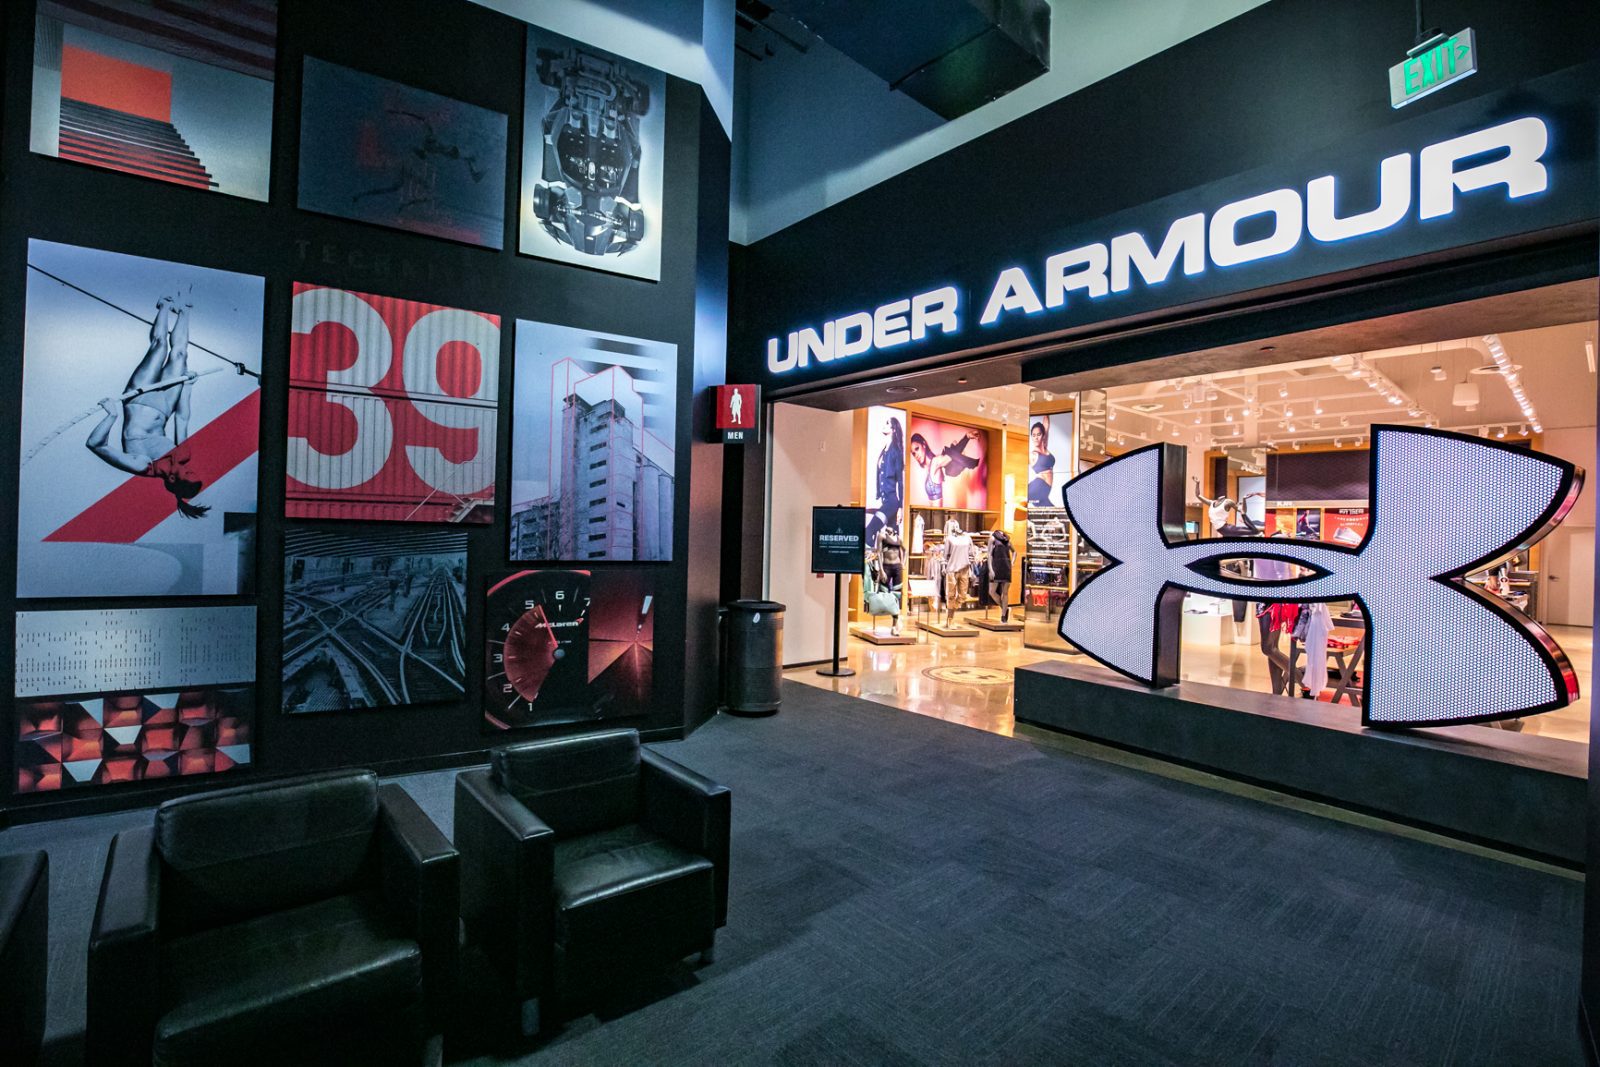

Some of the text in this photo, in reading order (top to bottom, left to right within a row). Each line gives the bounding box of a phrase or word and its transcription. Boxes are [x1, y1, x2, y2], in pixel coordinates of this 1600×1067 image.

[1404, 36, 1458, 96] EXIT
[767, 116, 1549, 374] UNDER ARMOUR
[285, 287, 501, 495] 39
[727, 431, 744, 440] MEN
[819, 534, 860, 542] RESERVED
[555, 591, 565, 600] 6
[524, 600, 534, 610] 5
[584, 597, 591, 607] 7
[501, 623, 510, 632] 4
[493, 654, 503, 664] 3
[503, 683, 513, 693] 2
[527, 702, 533, 712] 1
